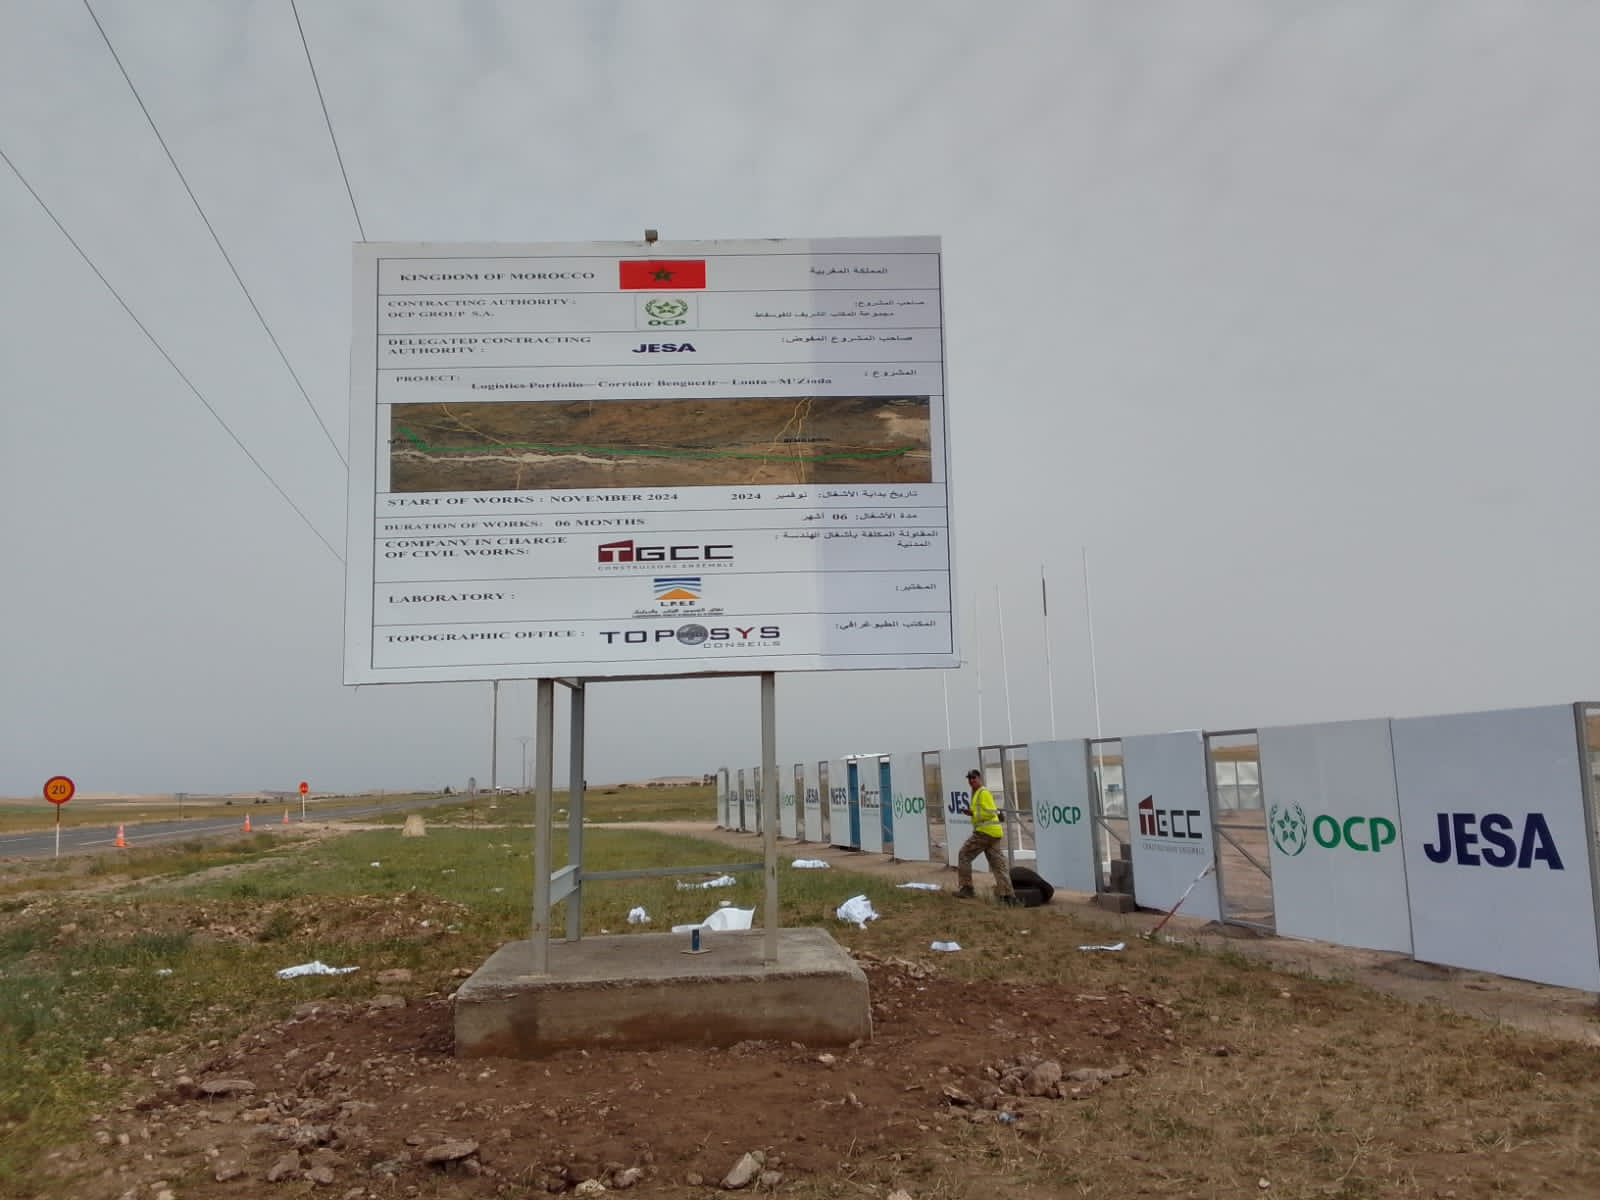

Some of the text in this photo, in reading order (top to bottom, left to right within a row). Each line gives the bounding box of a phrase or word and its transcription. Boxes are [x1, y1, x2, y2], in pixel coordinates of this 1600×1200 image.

[400, 271, 595, 281] KINGDOM OF MOROCCO
[489, 298, 569, 306] AUTHORITY
[481, 336, 592, 344] CONTRACTING
[388, 346, 475, 355] AUTHORITY
[631, 343, 697, 353] JESA
[387, 498, 441, 506] START
[445, 497, 471, 505] OF
[473, 496, 535, 505] WORKS
[550, 494, 643, 503] NOVEMBER
[646, 493, 679, 501] 2024
[730, 493, 762, 501] 2024
[384, 523, 457, 531] DURATION
[460, 521, 480, 529] OF
[554, 519, 571, 528] 06
[575, 518, 647, 527] MONTHS
[384, 536, 568, 549] COMPANY IN CHARGE
[384, 550, 409, 559] OF
[411, 550, 459, 558] CIVIL
[598, 540, 734, 563] TGCC
[389, 593, 505, 604] LABORATORY
[386, 632, 512, 644] TOPOGRAPHIC
[514, 630, 577, 640] OFFICE
[703, 640, 782, 649] CONSEILS
[51, 784, 66, 795] 20
[904, 796, 926, 814] OCP
[948, 791, 972, 815] JES
[1052, 805, 1082, 825] OCP
[1312, 814, 1397, 852] OCP
[1423, 812, 1565, 871] JESA
